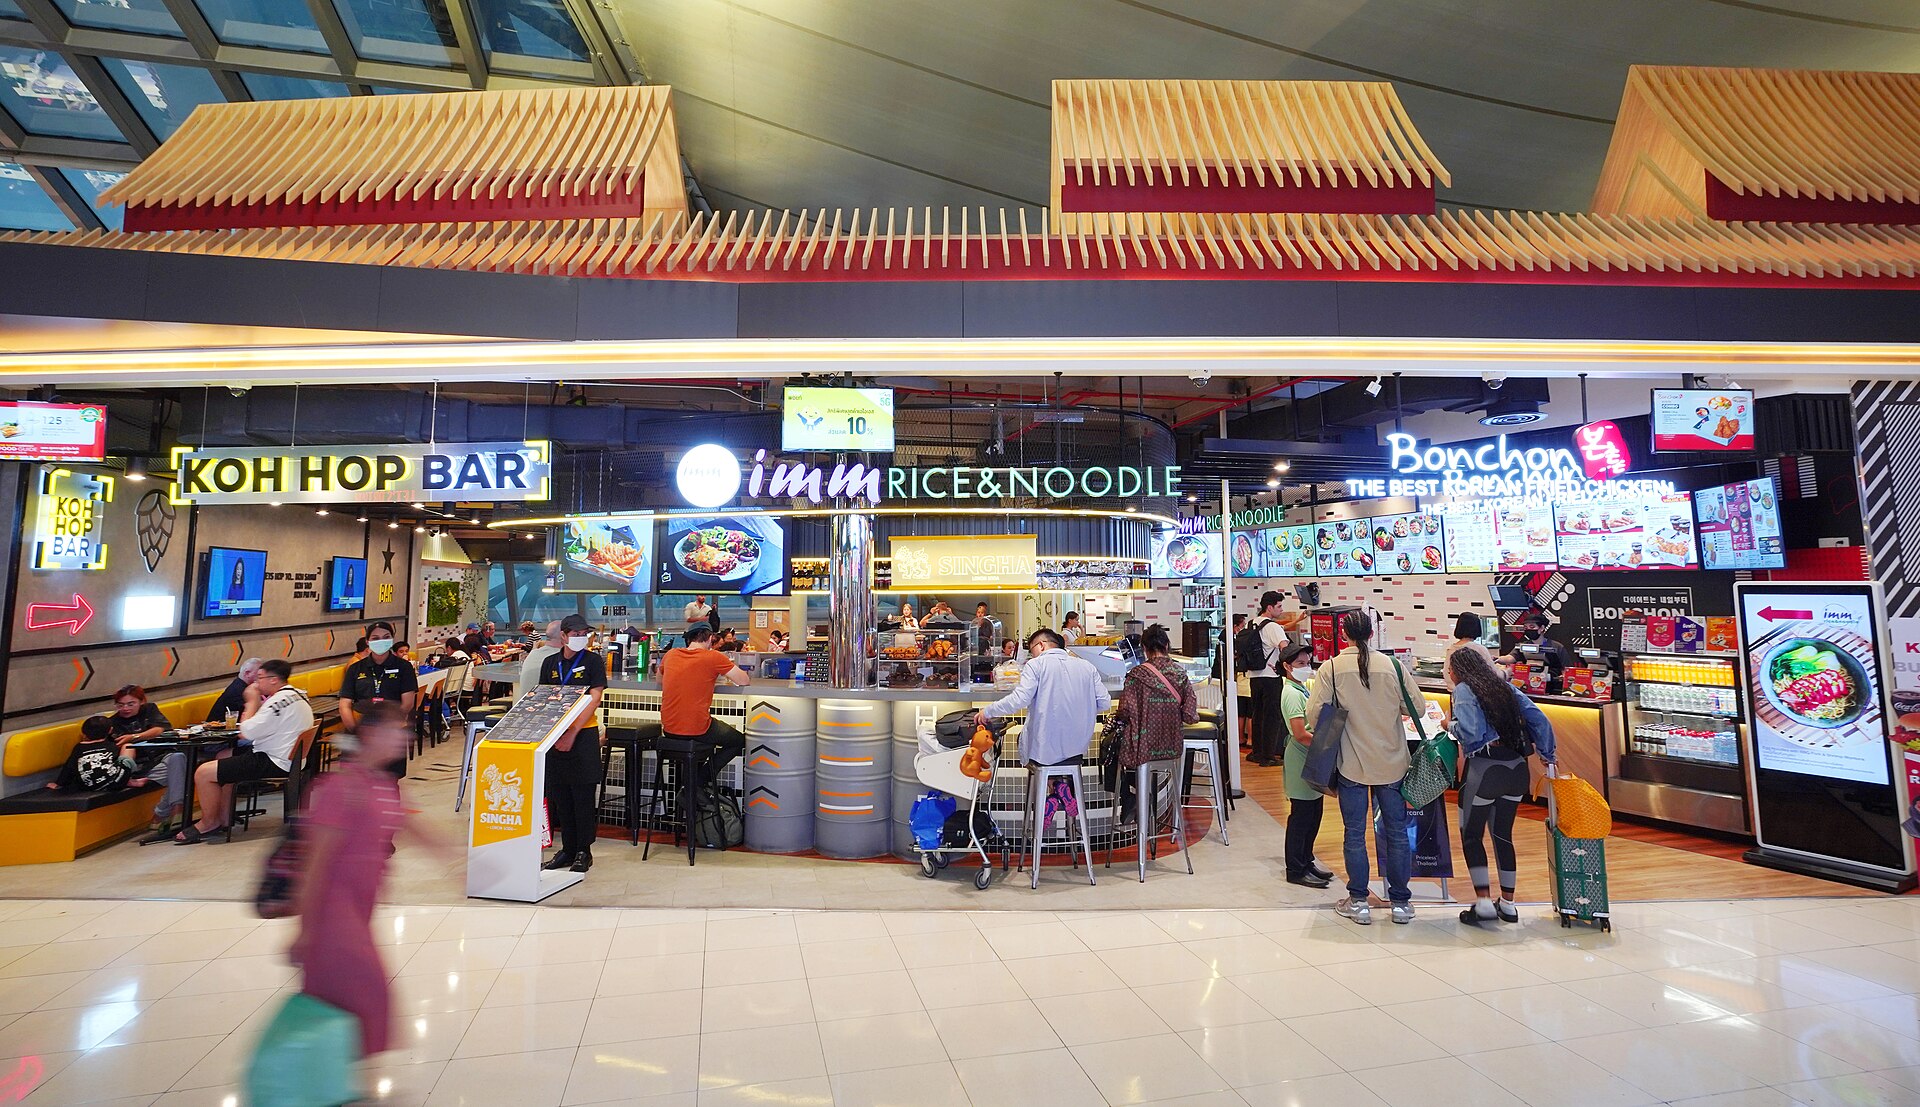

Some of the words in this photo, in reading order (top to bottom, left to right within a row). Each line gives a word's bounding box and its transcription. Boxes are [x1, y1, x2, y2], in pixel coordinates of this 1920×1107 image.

[880, 397, 891, 406] 5G
[1386, 433, 1581, 473] Bonchon
[183, 457, 284, 493] KOH
[300, 455, 407, 492] HOP
[422, 453, 528, 490] BAR
[749, 449, 881, 503] imm
[888, 466, 1182, 499] RICE&NOODLE
[1346, 479, 1386, 497] THE
[1390, 479, 1439, 497] BEST
[1443, 479, 1522, 497] KOREAN
[1525, 479, 1582, 497] FRIED
[57, 497, 93, 518] KOH
[54, 517, 93, 536] HOP
[1206, 505, 1284, 531] RIC&NOODLE
[53, 536, 90, 556] BAR
[938, 555, 1033, 576] SINGHA
[1593, 606, 1685, 620] BONHON
[1824, 608, 1852, 619] imm
[480, 812, 523, 826] SINGHA
